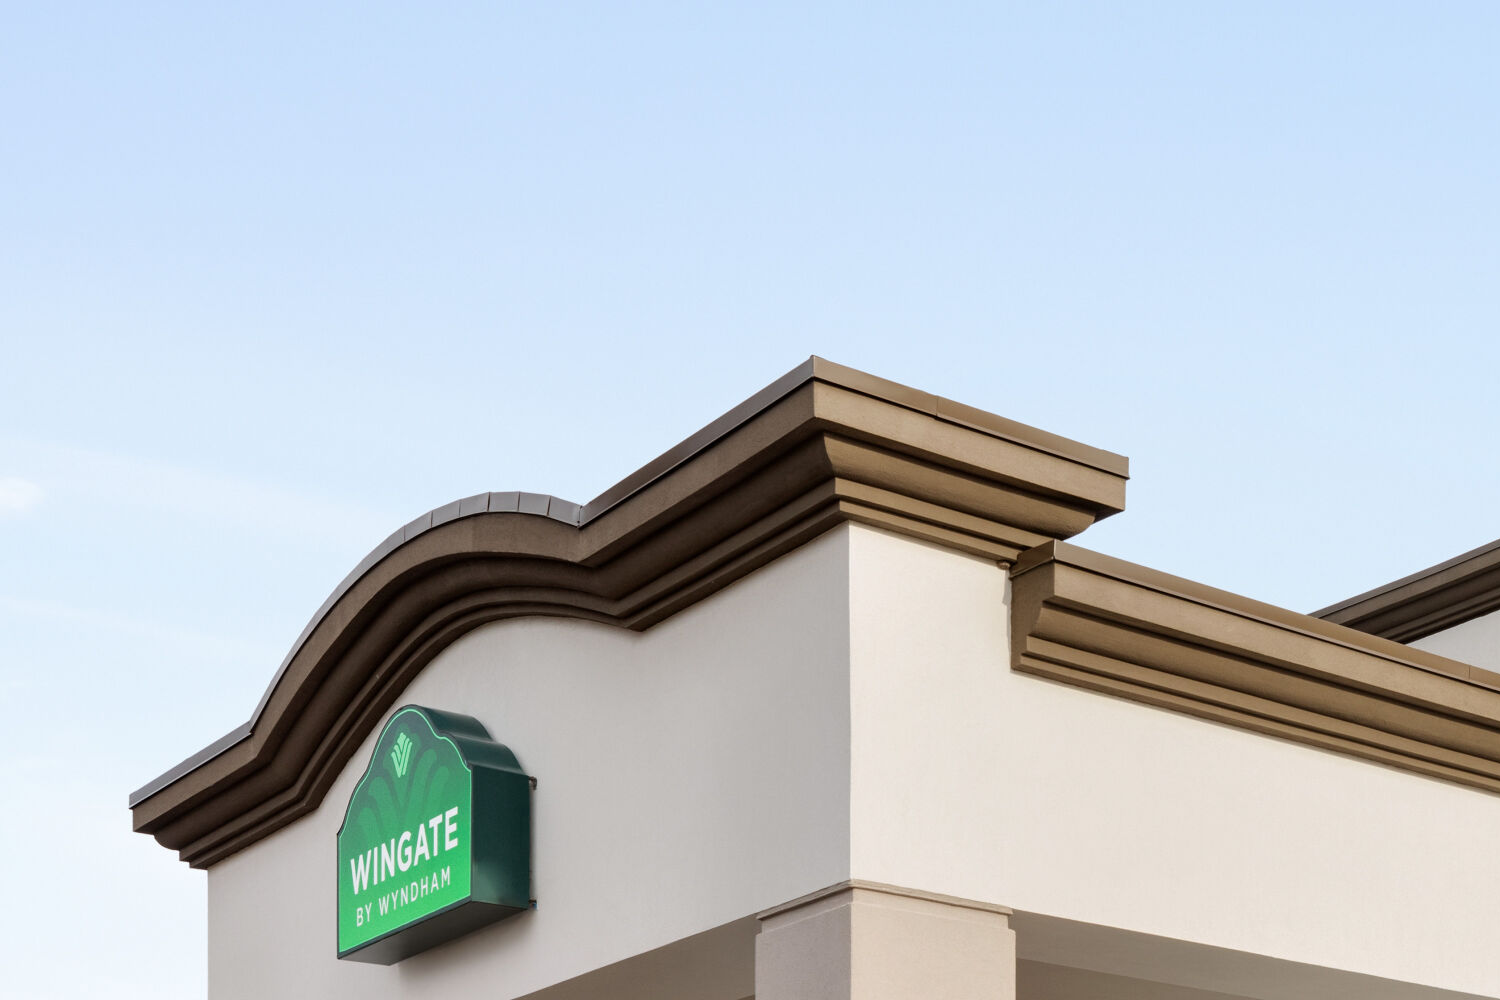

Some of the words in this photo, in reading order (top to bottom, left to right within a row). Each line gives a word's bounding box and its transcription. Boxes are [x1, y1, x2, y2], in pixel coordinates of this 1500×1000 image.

[350, 806, 459, 895] WINGATE
[356, 902, 372, 927] BY
[378, 865, 451, 917] WYNDHAM
